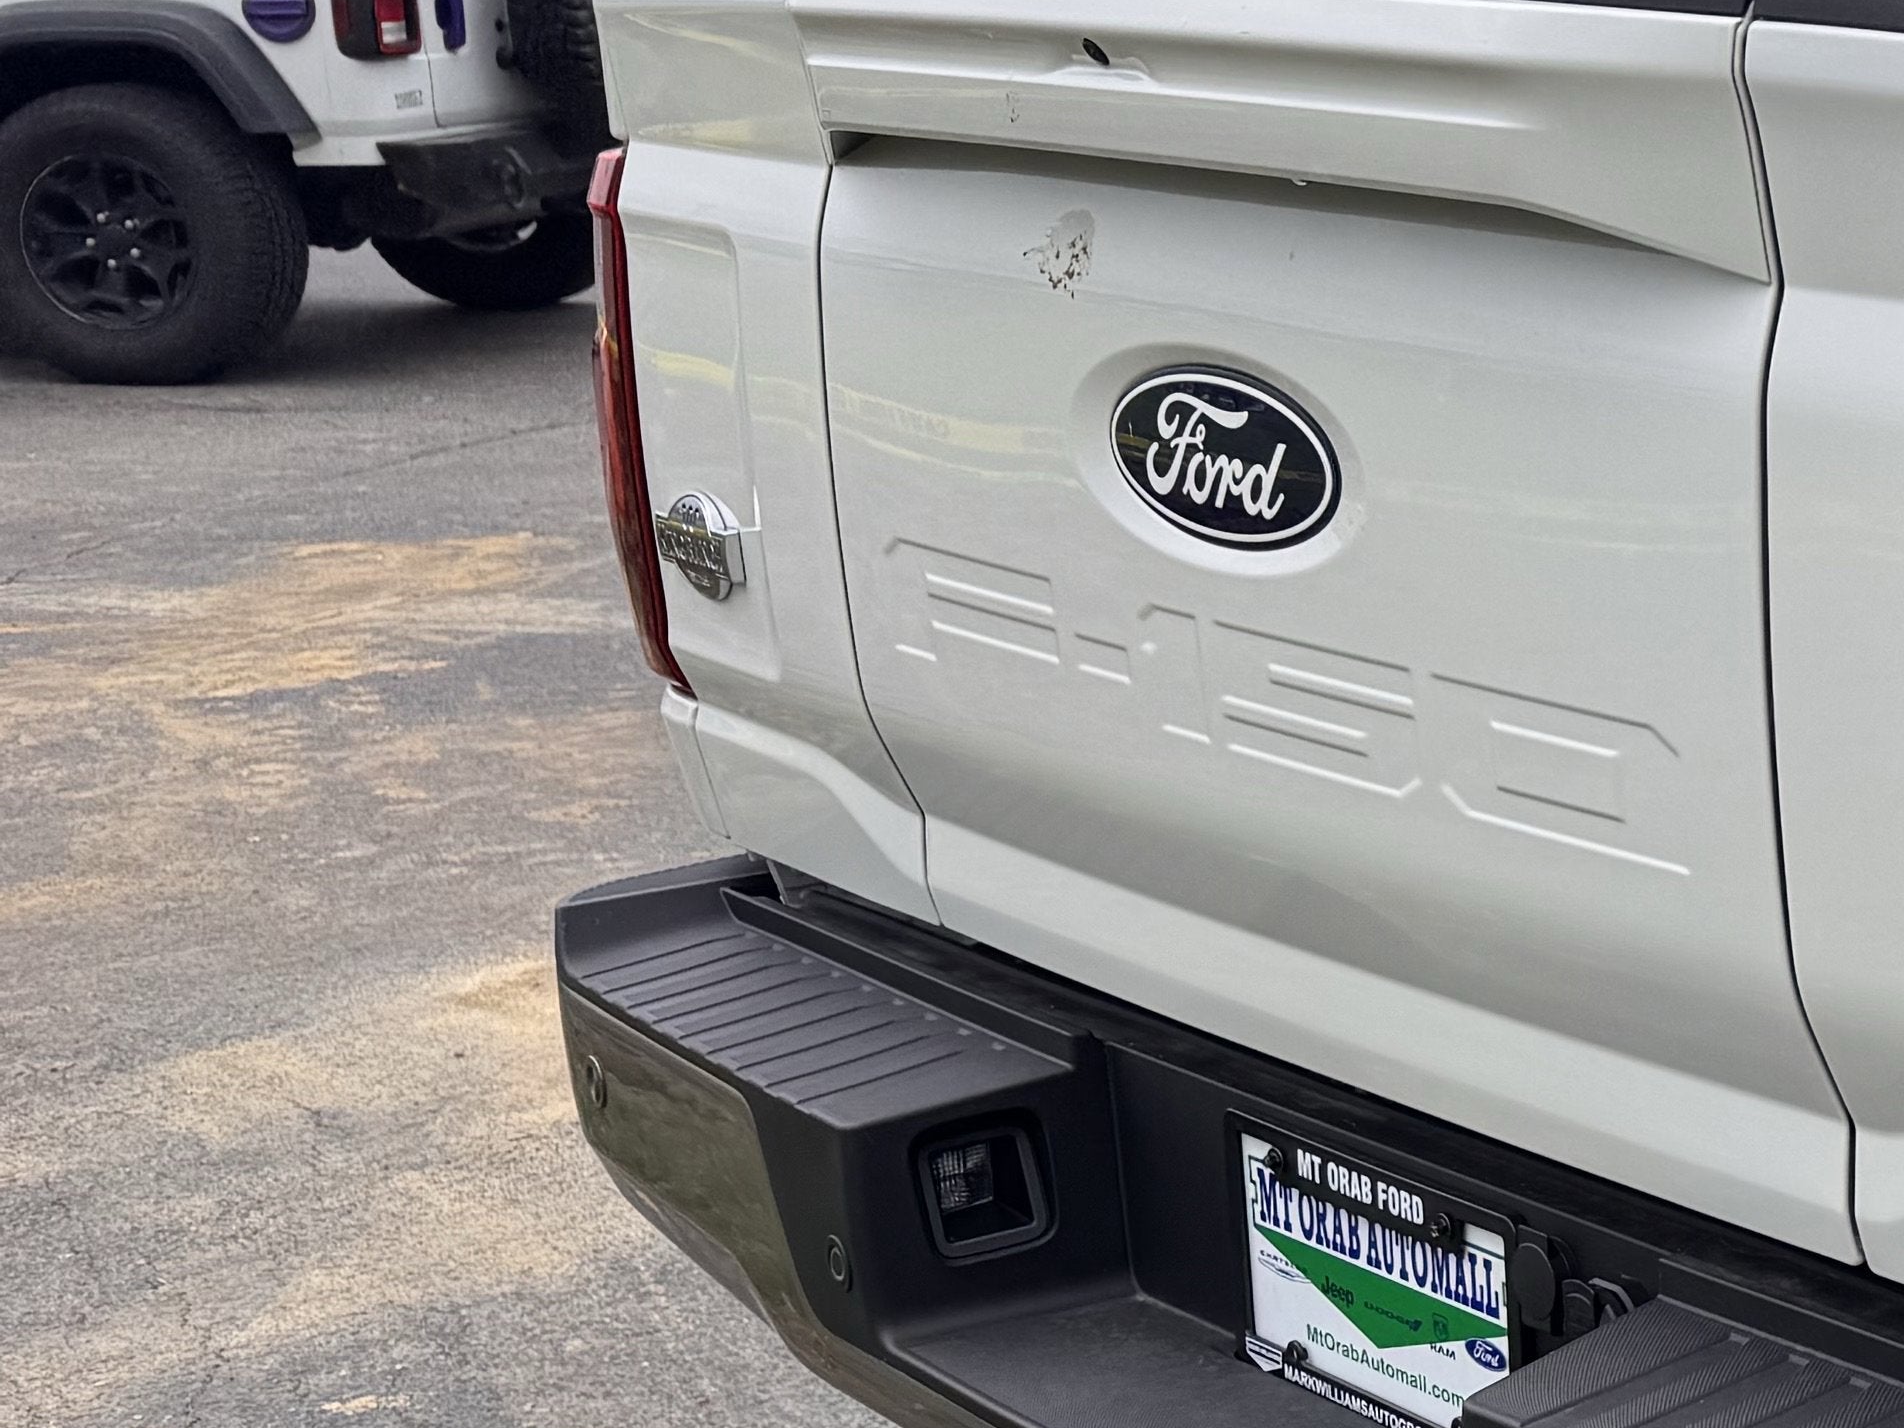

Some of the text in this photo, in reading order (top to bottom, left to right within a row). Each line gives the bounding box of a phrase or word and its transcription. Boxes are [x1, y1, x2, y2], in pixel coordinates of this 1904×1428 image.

[1146, 392, 1287, 520] Ford
[1297, 1148, 1424, 1225] MT ORAB FORD
[1299, 1188, 1361, 1260] ORAB
[1366, 1221, 1501, 1321] AUTOMALL
[1321, 1275, 1355, 1309] Jeep
[1306, 1323, 1465, 1408] MtOrabAutomall.com
